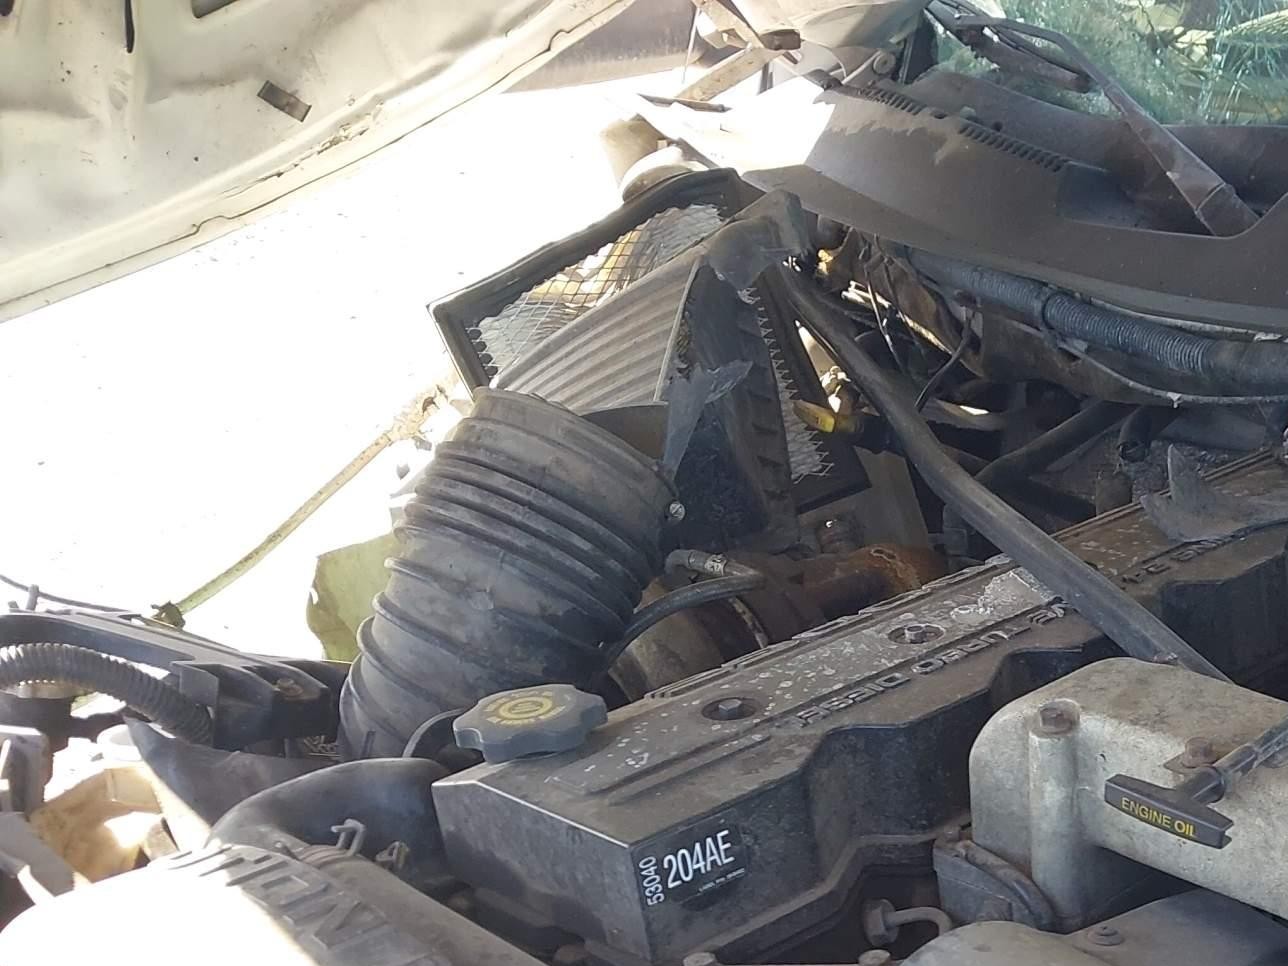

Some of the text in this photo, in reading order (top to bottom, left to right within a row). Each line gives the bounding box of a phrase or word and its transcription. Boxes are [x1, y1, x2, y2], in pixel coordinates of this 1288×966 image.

[1121, 797, 1197, 837] ENGINE OIL
[638, 856, 665, 906] 53040
[662, 829, 736, 891] 204AE
